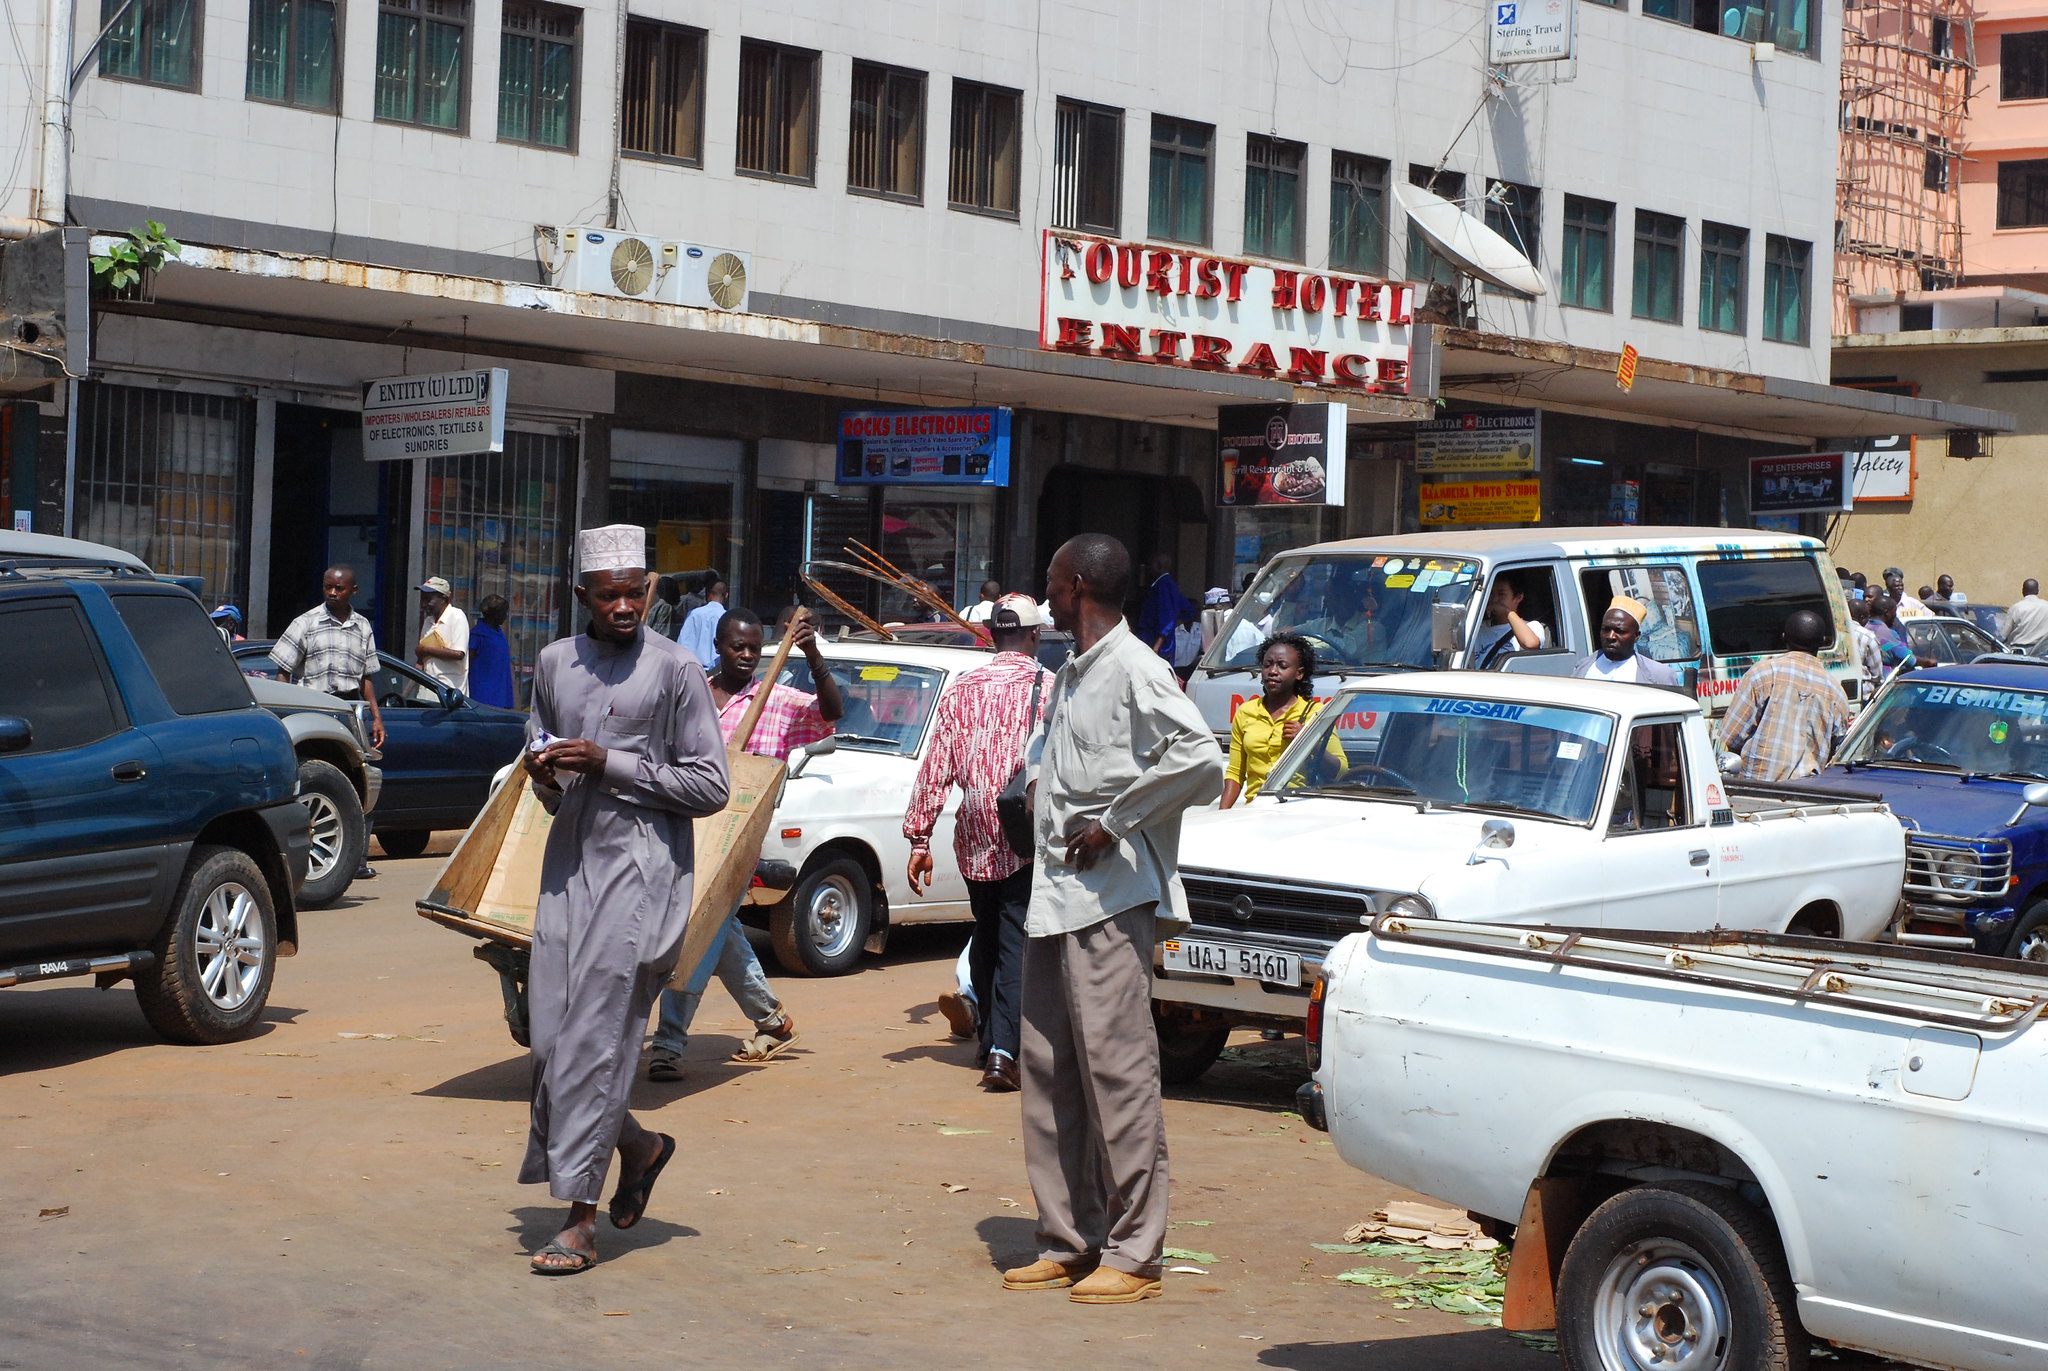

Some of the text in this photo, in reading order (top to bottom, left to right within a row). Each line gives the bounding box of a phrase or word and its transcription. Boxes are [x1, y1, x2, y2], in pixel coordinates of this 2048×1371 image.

[1496, 23, 1562, 38] Sterling Travel
[1525, 38, 1532, 46] &
[1496, 49, 1512, 58] Tours
[1513, 47, 1537, 56] Services
[1538, 46, 1548, 55] (U)
[1055, 237, 1412, 326] TOURIST HOTEL
[1056, 316, 1409, 384] ENTRANCE
[379, 380, 426, 402] ENTITY
[427, 375, 446, 398] (U)
[449, 376, 475, 396] LTD
[369, 420, 484, 441] OF ELECTRONICS, TEXTILES &
[843, 413, 991, 437] ROCKS ELECTRONICS
[404, 439, 449, 454] SUNDRIES
[1287, 433, 1323, 445] HOTEL
[1249, 463, 1295, 475] Restaurant
[1295, 465, 1303, 473] &
[1775, 460, 1831, 473] ENTERPRISES
[1424, 699, 1526, 720] NISSAN
[39, 961, 69, 975] RAV4
[1188, 944, 1288, 981] UAJ 516D
